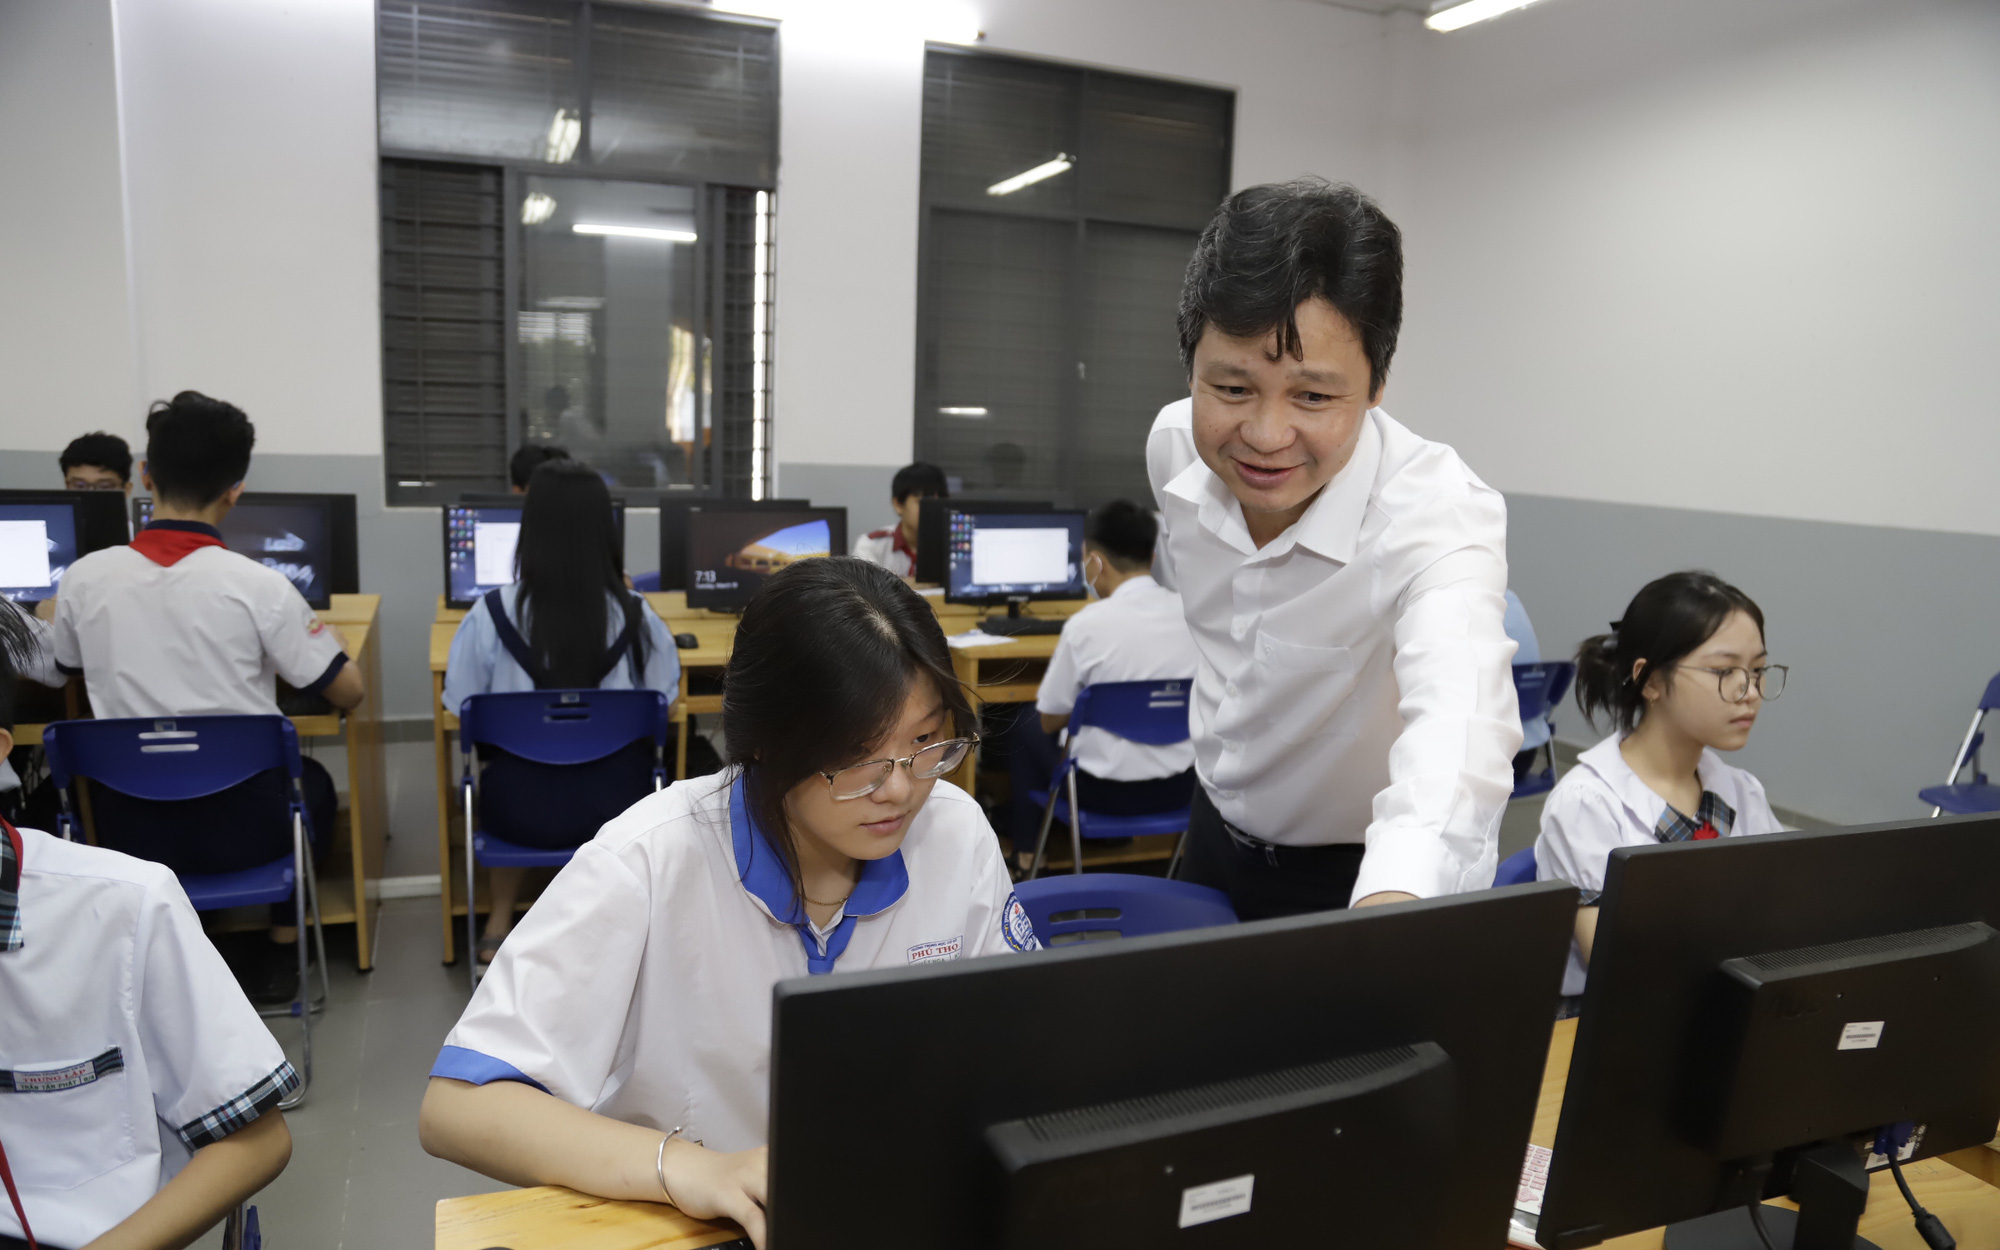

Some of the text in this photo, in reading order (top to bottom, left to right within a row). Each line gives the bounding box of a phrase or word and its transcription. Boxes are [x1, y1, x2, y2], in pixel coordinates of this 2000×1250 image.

[912, 943, 959, 960] PHÚ THỌ
[23, 1075, 61, 1083] TRUNG
